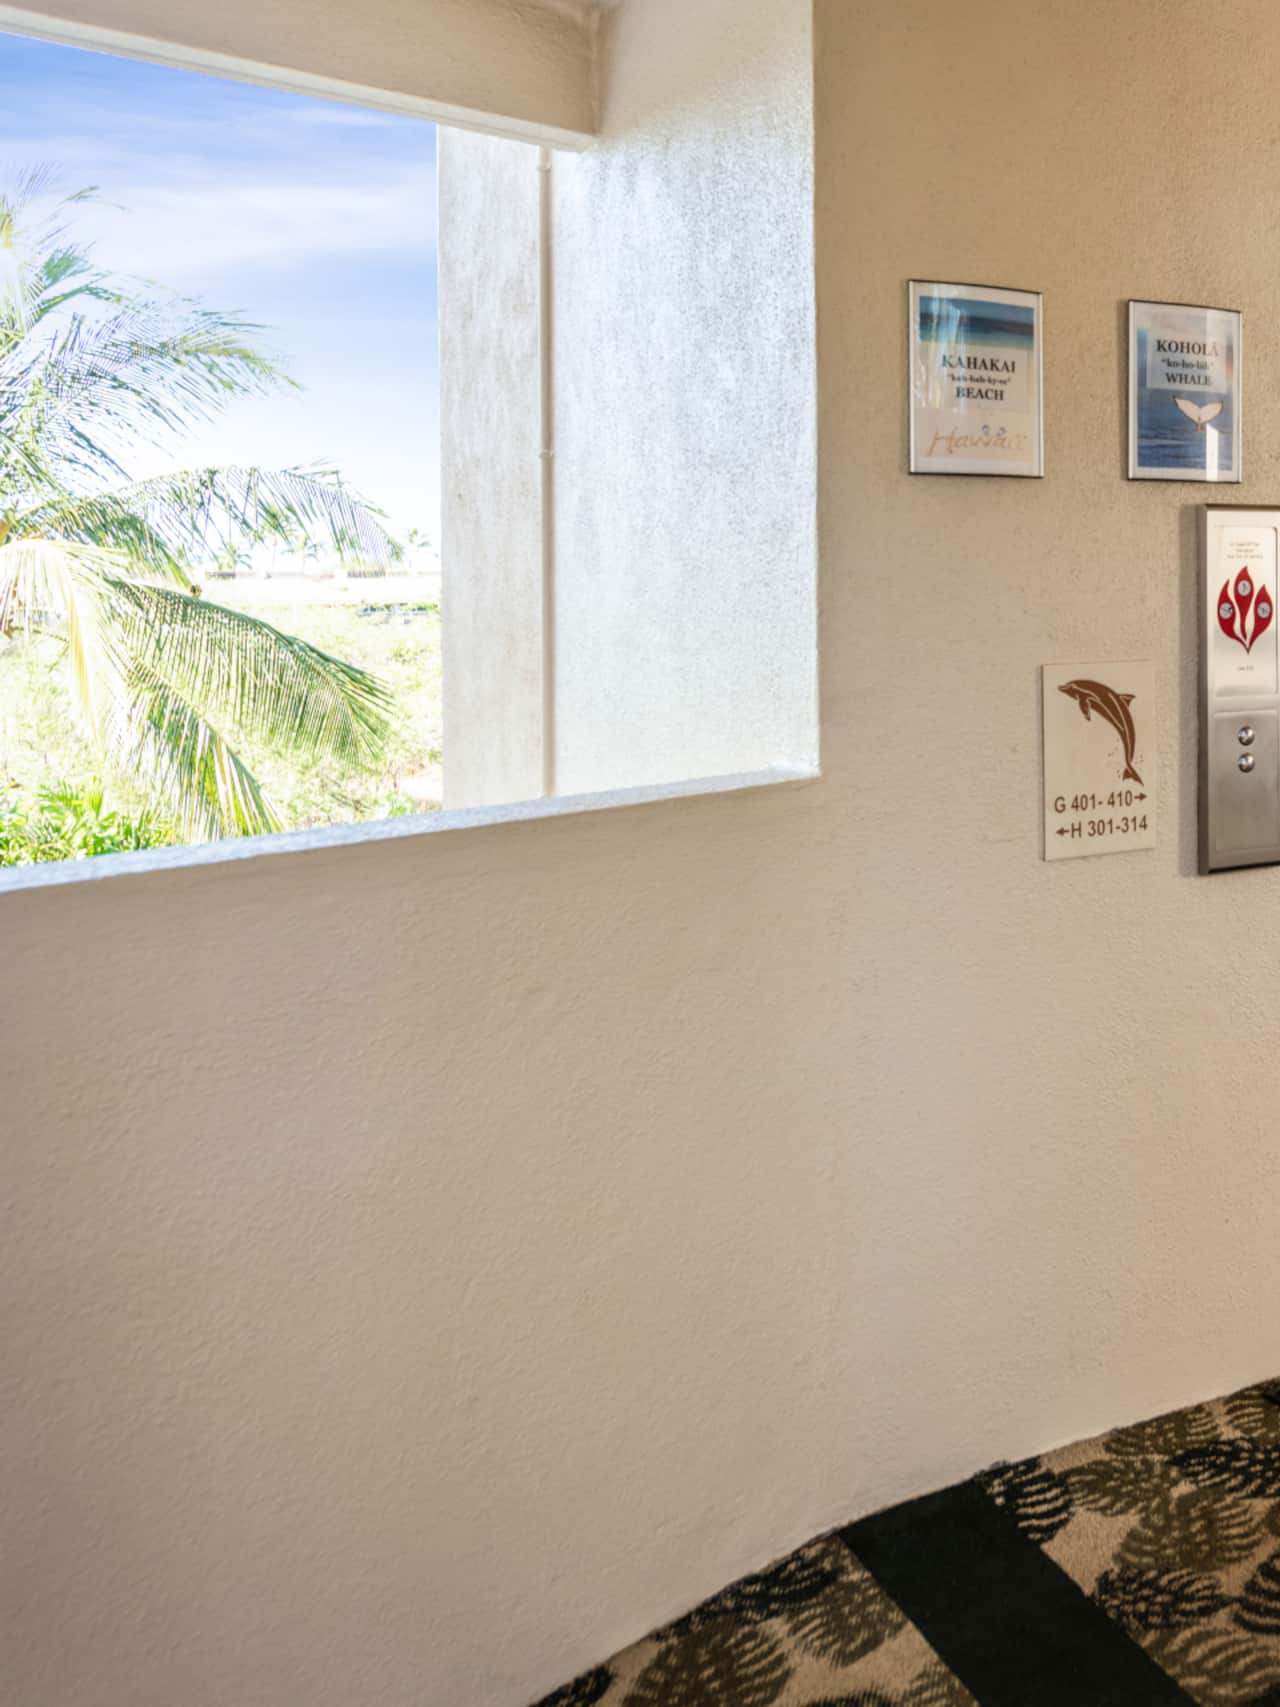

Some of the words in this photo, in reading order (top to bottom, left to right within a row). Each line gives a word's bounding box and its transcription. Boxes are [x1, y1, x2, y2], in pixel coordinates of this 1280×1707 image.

[942, 354, 1016, 373] KAHAKAI
[1165, 372, 1212, 386] WHALE
[956, 387, 1005, 401] BEACH
[1054, 796, 1066, 813] G
[1071, 821, 1082, 839] H
[1087, 814, 1148, 837] 301-314
